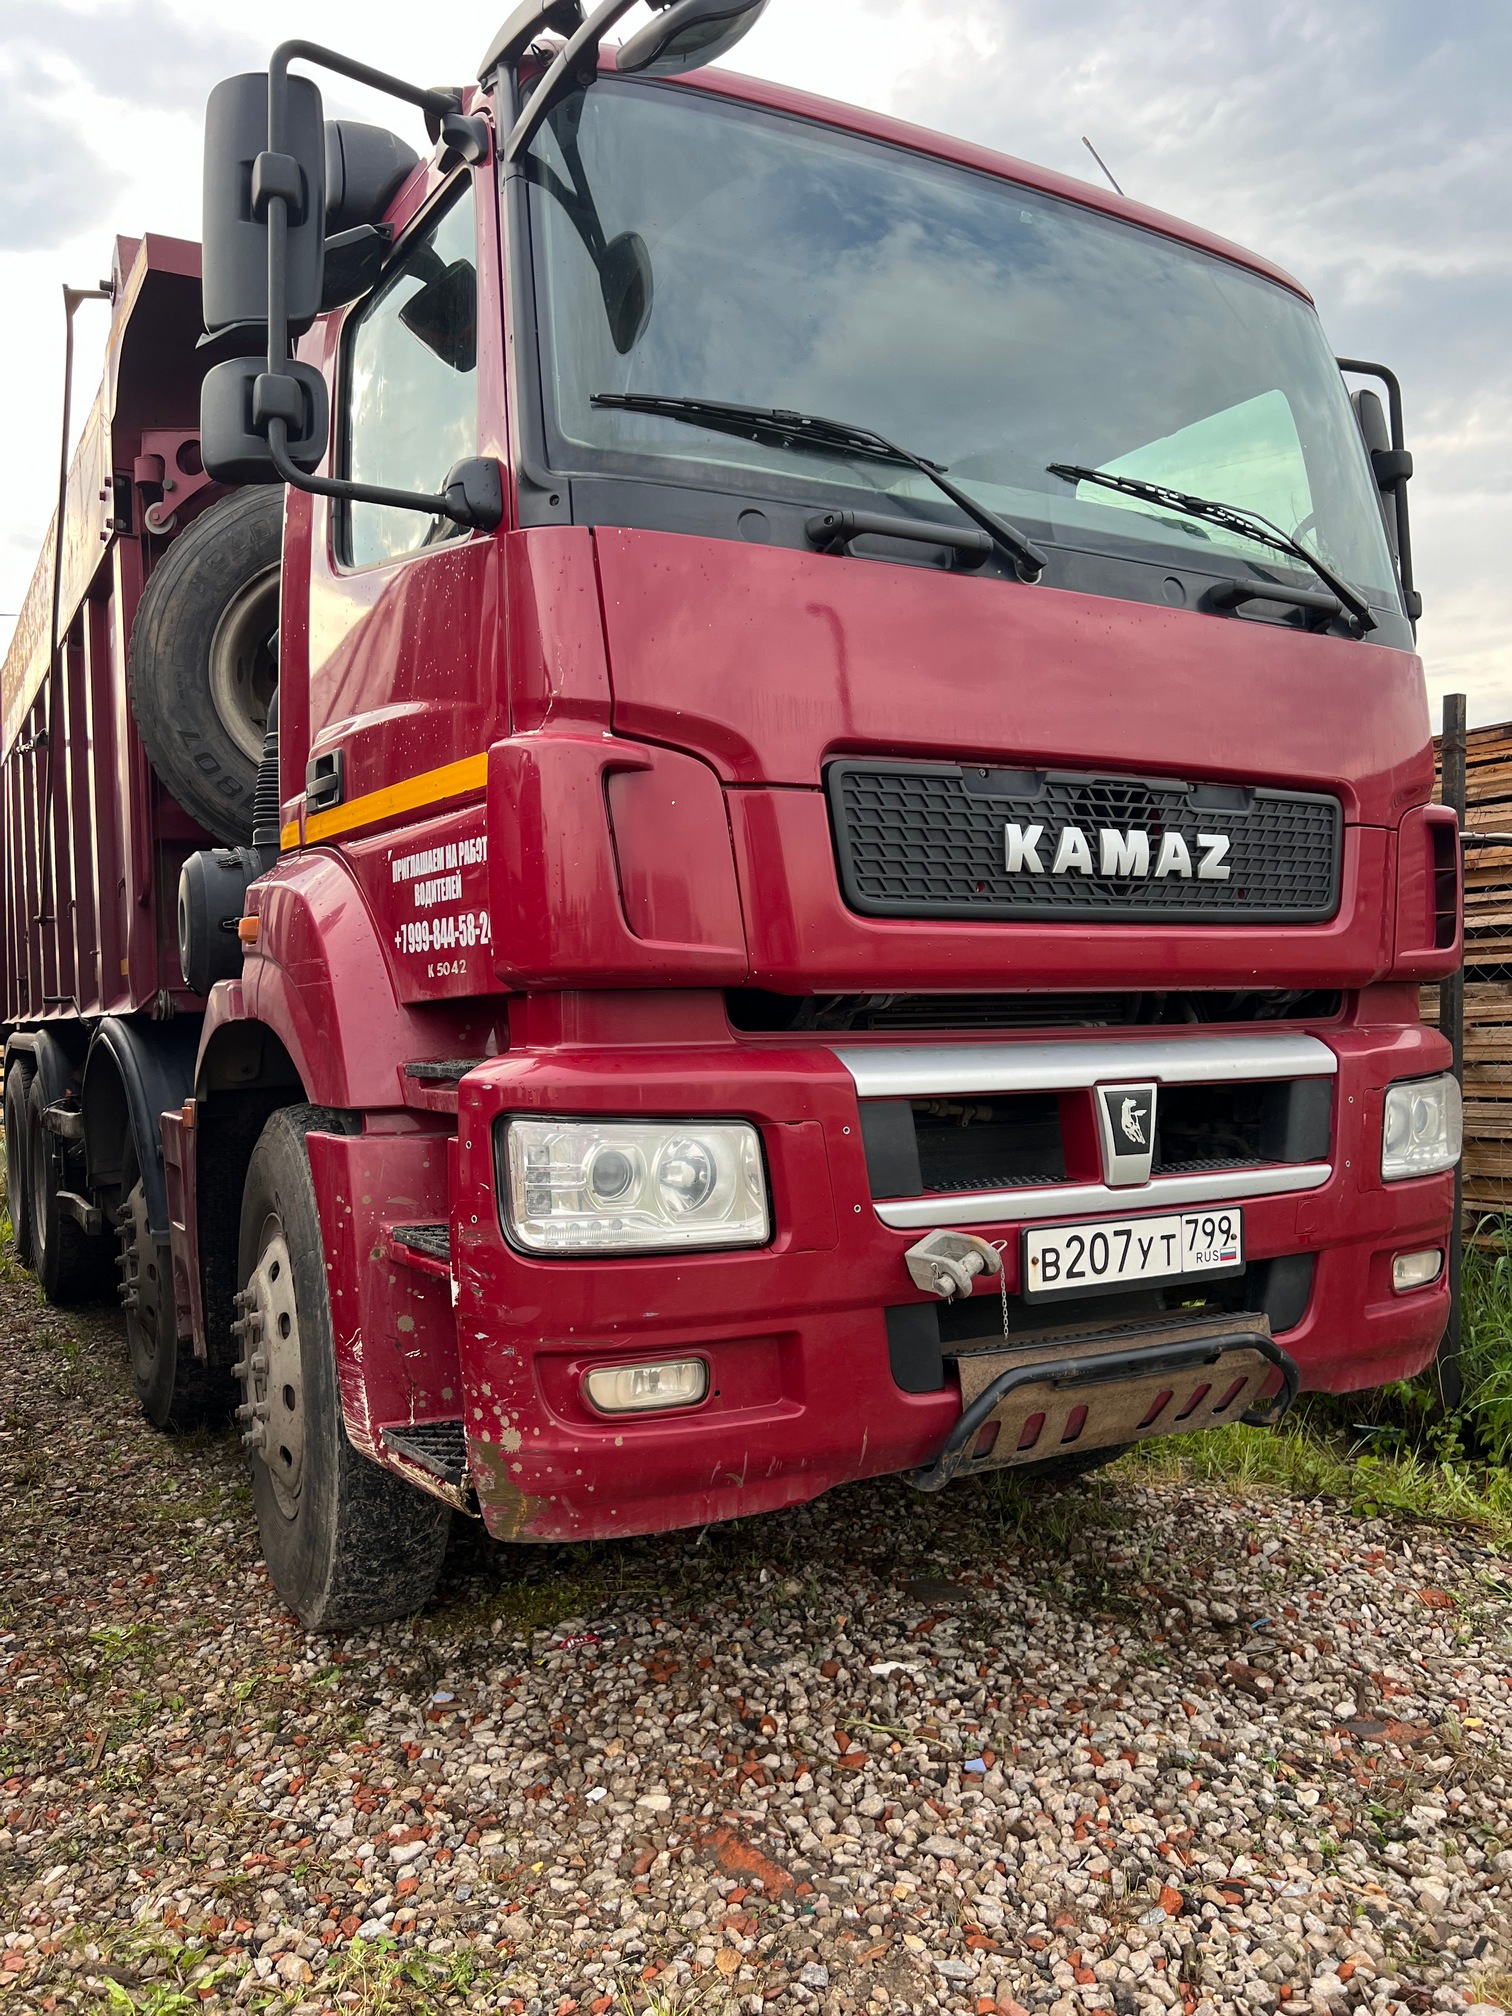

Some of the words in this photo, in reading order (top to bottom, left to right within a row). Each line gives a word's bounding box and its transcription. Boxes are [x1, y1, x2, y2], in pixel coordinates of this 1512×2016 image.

[392, 846, 445, 883] ПРИГЛАШАЕМ
[445, 843, 458, 869] НА
[1004, 823, 1231, 880] KAMAZ
[414, 869, 462, 908] ВОДИТЕЛЕЙ
[437, 959, 467, 977] 5042
[1185, 1215, 1232, 1251] 799
[1196, 1249, 1219, 1263] RUS
